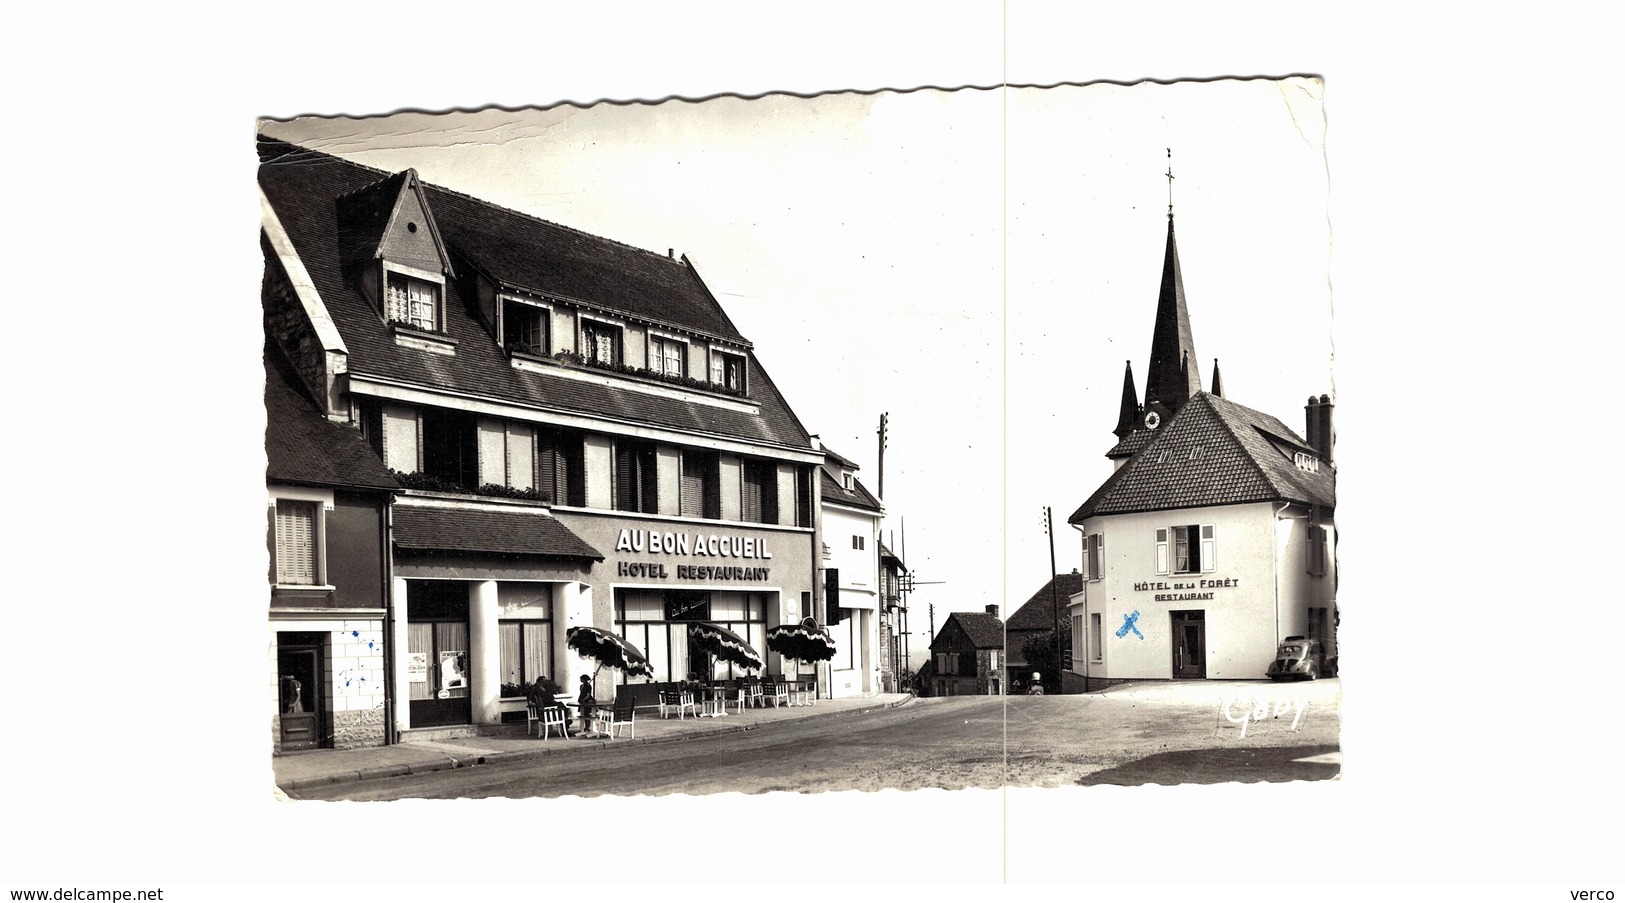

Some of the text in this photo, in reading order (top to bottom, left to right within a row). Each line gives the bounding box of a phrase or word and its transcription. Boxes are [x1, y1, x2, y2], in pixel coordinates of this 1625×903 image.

[615, 528, 773, 560] AU BON ACCUEIL
[618, 561, 771, 582] HOTEL RESTAURANT
[1134, 581, 1171, 591] HÔTEL
[1200, 577, 1239, 589] FORÊT
[1154, 592, 1214, 602] RESTAURANT
